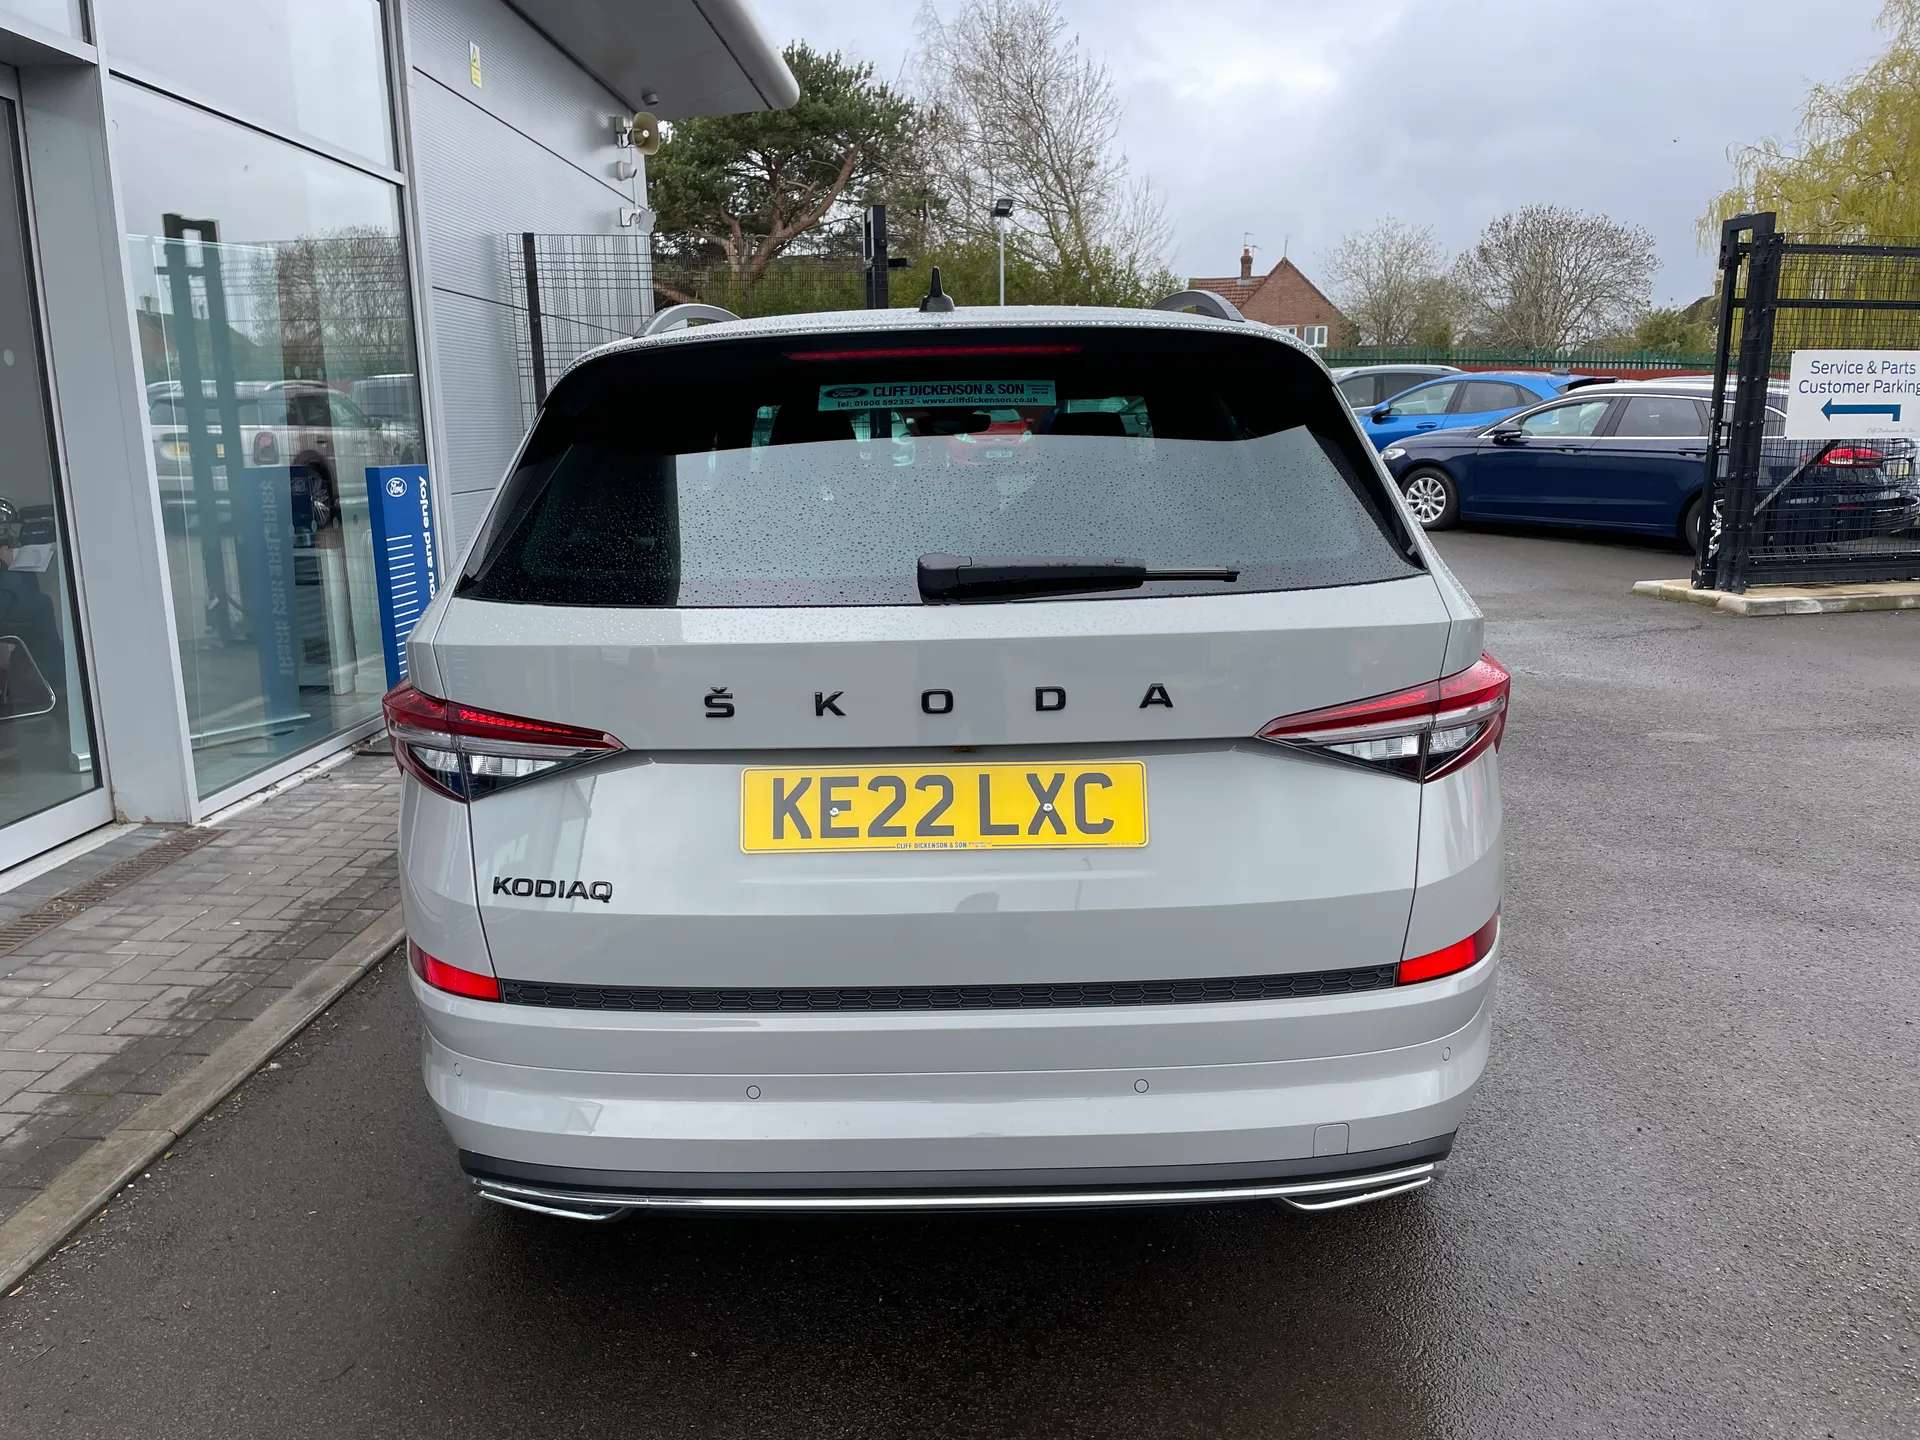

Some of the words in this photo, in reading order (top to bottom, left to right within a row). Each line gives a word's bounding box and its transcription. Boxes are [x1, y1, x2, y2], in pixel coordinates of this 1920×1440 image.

[1810, 361, 1864, 374] Service
[1867, 361, 1877, 374] &
[1881, 361, 1916, 374] Parts
[873, 385, 909, 397] CLIFF
[910, 384, 982, 396] DICKENSON
[985, 384, 994, 395] &
[998, 384, 1025, 395] SON
[1799, 380, 1870, 393] Customer
[1874, 379, 1920, 396] Parking
[418, 476, 430, 529] enjoy
[422, 532, 434, 569] and
[428, 571, 436, 600] ou
[704, 683, 1175, 718] ŠKODA
[772, 774, 955, 840] KE22
[978, 772, 1115, 837] LXC
[492, 876, 613, 903] KODIAQ
